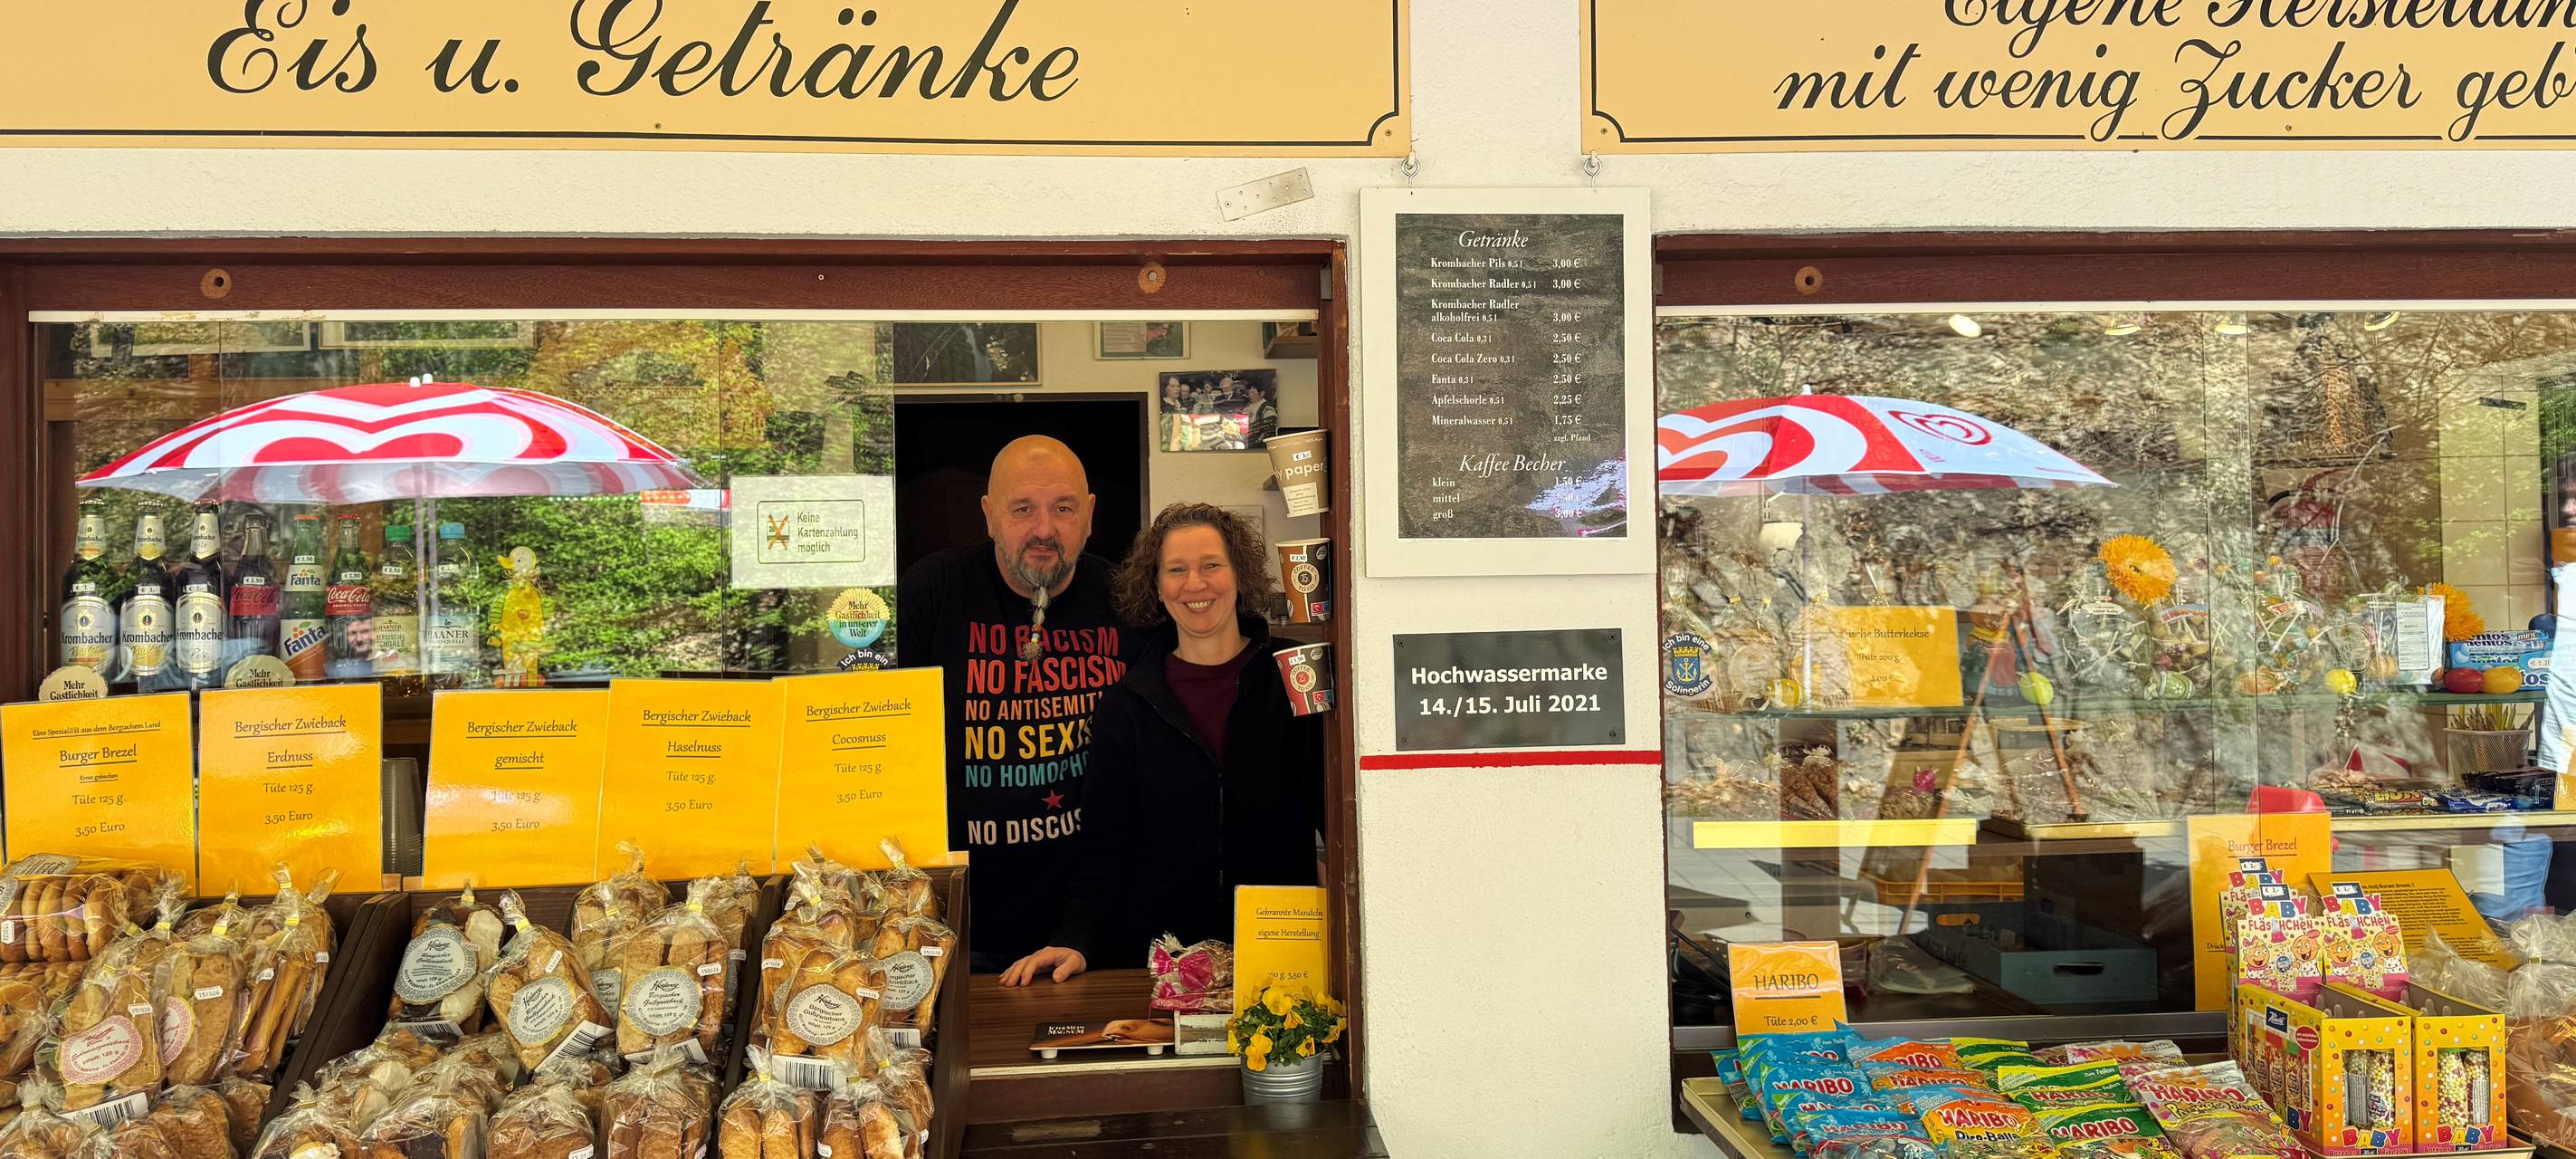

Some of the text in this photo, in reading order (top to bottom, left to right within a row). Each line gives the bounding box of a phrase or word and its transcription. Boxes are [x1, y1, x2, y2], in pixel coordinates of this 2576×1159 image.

[207, 0, 1079, 101] Eis u. Getränke
[1774, 39, 2576, 142] mit wenig Zucker geb
[1459, 230, 1529, 248] Getränke
[1431, 257, 1486, 267] Krombacher
[1489, 257, 1505, 267] Pils
[1552, 259, 1570, 268] 3,00
[1574, 259, 1580, 267] €
[1431, 279, 1486, 288] Krombacher
[1489, 279, 1520, 288] Radler
[1553, 280, 1570, 289] 3,00
[1574, 280, 1580, 288] €
[1431, 299, 1520, 309] Krombacher Radler
[1431, 312, 1480, 321] alkoholfrei
[1553, 313, 1571, 322] 3,00
[1575, 313, 1581, 321] €
[1431, 333, 1452, 342] Coca
[1455, 333, 1474, 342] Cola
[1553, 334, 1571, 343] 2,50
[1575, 333, 1581, 341] €
[1432, 375, 1455, 383] Fanta
[1553, 375, 1572, 384] 2,50
[1575, 375, 1581, 383] €
[1432, 395, 1487, 407] Apfelschorle
[1553, 395, 1572, 405] 2,25
[1575, 395, 1581, 404] €
[1432, 416, 1495, 425] Mineralwasser
[1554, 416, 1572, 425] 1,75
[1575, 416, 1581, 424] €
[1570, 434, 1590, 442] Pfand
[1459, 453, 1566, 478] Kaffee Becher
[1433, 477, 1455, 487] klein
[1433, 493, 1460, 503] mittel
[797, 512, 820, 522] Keine
[1433, 511, 1453, 520] groß
[798, 527, 858, 539] Kartenzahlung
[798, 542, 831, 554] möglich
[291, 575, 320, 586] Fanta
[849, 601, 868, 609] Mehr
[122, 631, 173, 643] Krombacher
[850, 629, 867, 637] Welt
[1874, 627, 1930, 637] Butterkekse
[284, 625, 326, 656] Fanta
[968, 622, 1007, 655] NO
[1663, 634, 1709, 650] Ich bin eine
[841, 649, 888, 666] Ich bin ein
[250, 669, 271, 678] Mehr
[967, 659, 1005, 694] NO
[1412, 663, 1608, 685] Hochwassermarke
[64, 681, 85, 690] Mehr
[236, 679, 283, 688] Gastlichkeit
[1666, 680, 1710, 694] Solingerin
[50, 690, 98, 700] Gastlichkeit
[806, 698, 911, 718] Bergischer Zwieback
[966, 692, 1102, 720] NO ANTISEMIT
[1419, 694, 1600, 717] 14./15. Juli 2021
[644, 709, 751, 724] Bergischer Zwieback
[235, 715, 346, 734] Bergischer Zwieback
[467, 720, 577, 736] Bergischer Zwieback
[832, 733, 886, 744] Cocosnuss
[966, 726, 1006, 760] NO
[667, 740, 721, 752] Haselnuss
[60, 743, 137, 764] Burger Brezel
[267, 750, 313, 762] Erdnuss
[495, 751, 544, 768] gemischt
[666, 771, 688, 781] Tüte
[692, 773, 705, 783] 125
[966, 765, 991, 787] NO
[263, 782, 286, 792] Tüte
[290, 784, 303, 792] 125
[72, 794, 96, 804] Tüte
[100, 796, 113, 805] 125
[666, 800, 712, 811] 3,50 Euro
[265, 810, 312, 824] 3,50 Euro
[75, 822, 125, 838] 3,50 Euro
[968, 820, 996, 845] NO
[2228, 837, 2297, 855] Burger Brezel
[1256, 907, 1291, 915] Gebrannte
[2248, 896, 2307, 918] BABY
[2323, 895, 2380, 915] BABY
[1258, 928, 1319, 939] eigene Herstellung
[1753, 973, 1819, 991] HARIBO
[1764, 1015, 1818, 1028] Tüte 2,00 €
[2149, 1085, 2247, 1104] HARIBO
[2051, 1116, 2140, 1140] HARIBO
[2342, 1126, 2401, 1148] BABY
[2437, 1125, 2495, 1145] BABY
